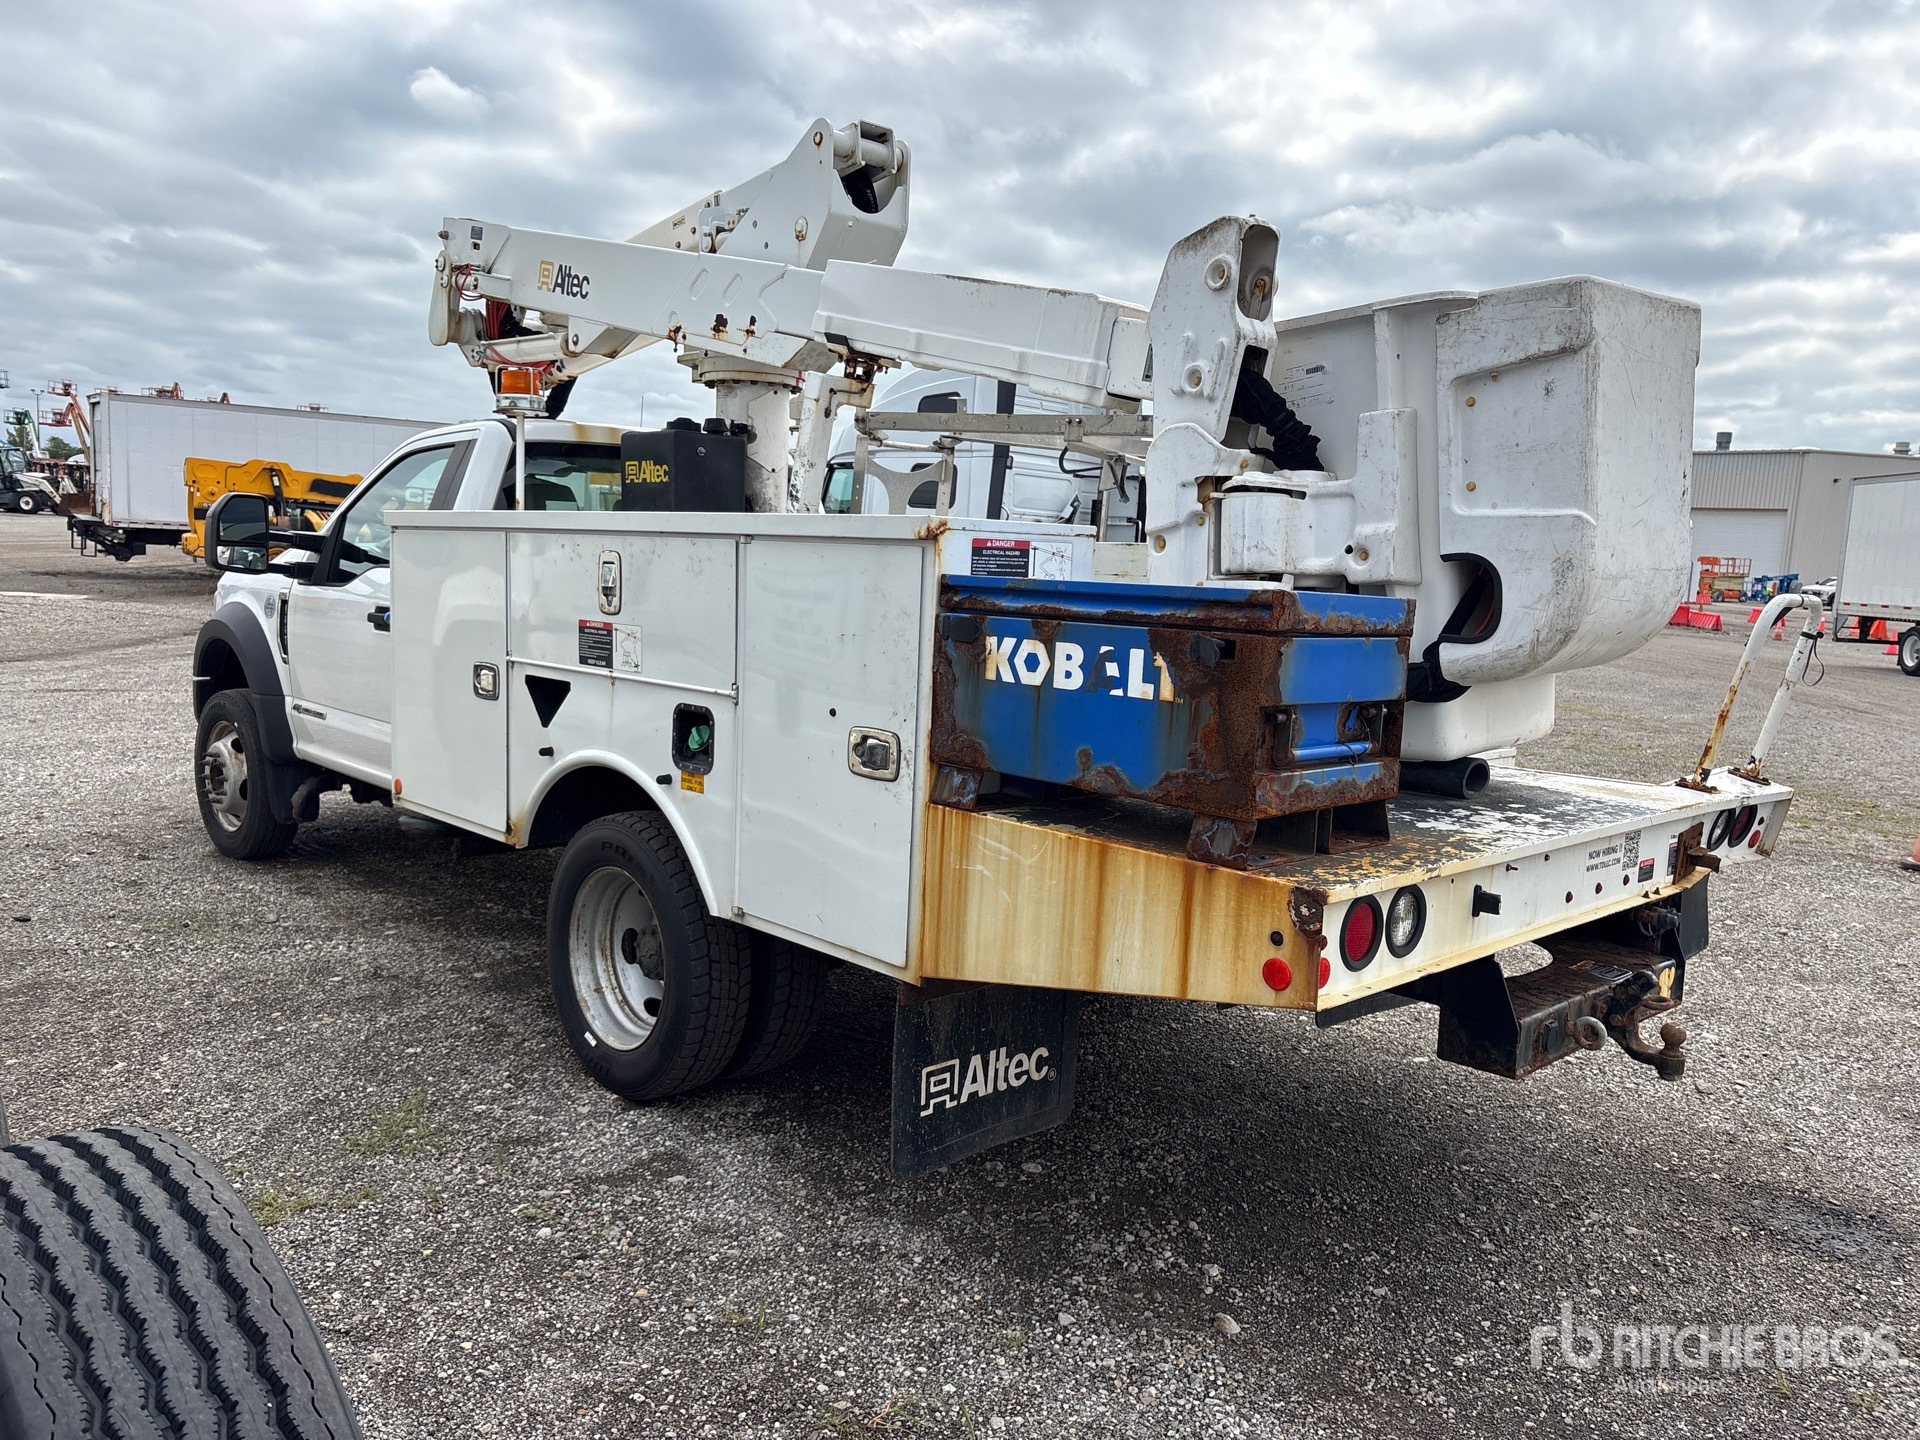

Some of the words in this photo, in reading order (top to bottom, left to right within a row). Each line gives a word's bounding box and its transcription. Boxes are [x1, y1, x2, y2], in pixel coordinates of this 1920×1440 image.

[552, 263, 590, 300] Altec
[639, 460, 669, 483] Altec
[1588, 849, 1601, 860] NOW
[1602, 844, 1618, 857] HIRING
